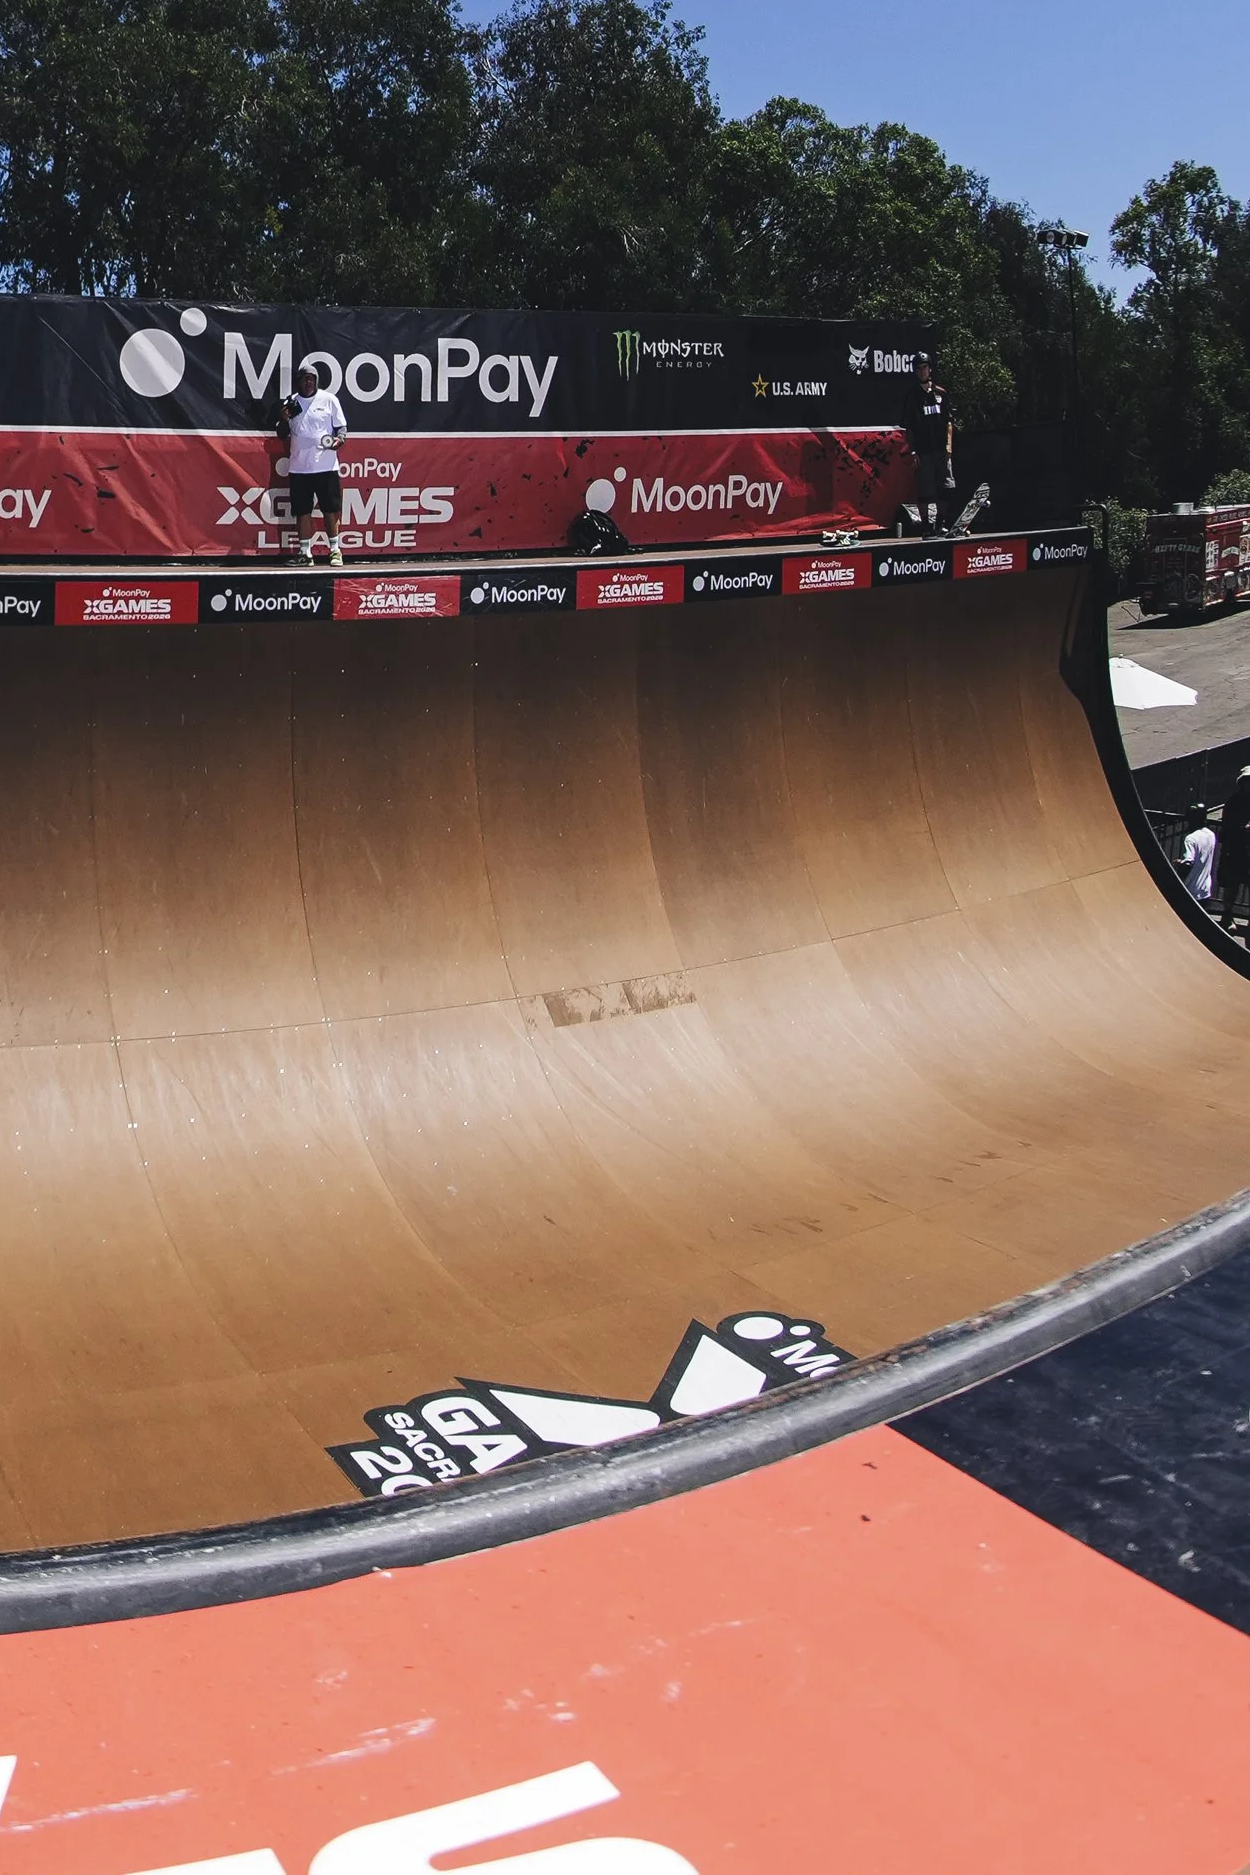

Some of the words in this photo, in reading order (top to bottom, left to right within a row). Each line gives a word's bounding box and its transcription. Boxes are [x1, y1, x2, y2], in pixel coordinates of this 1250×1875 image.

[642, 338, 725, 358] MONSTER
[655, 360, 714, 369] ENERGY
[873, 349, 914, 373] Bobc
[223, 331, 558, 418] MoonPay
[772, 382, 794, 396] U.S.
[795, 381, 828, 397] ARMY
[338, 457, 402, 482] onPay
[631, 475, 783, 515] MoonPay
[1044, 544, 1088, 560] MoonPay
[893, 558, 946, 575] MoonPay
[619, 573, 649, 582] MoonPay
[710, 572, 773, 591] MoonPay
[112, 588, 150, 598] MoonPay
[384, 583, 418, 593] MoonPay
[491, 584, 567, 604] MoonPay
[235, 592, 321, 613] MoonPay
